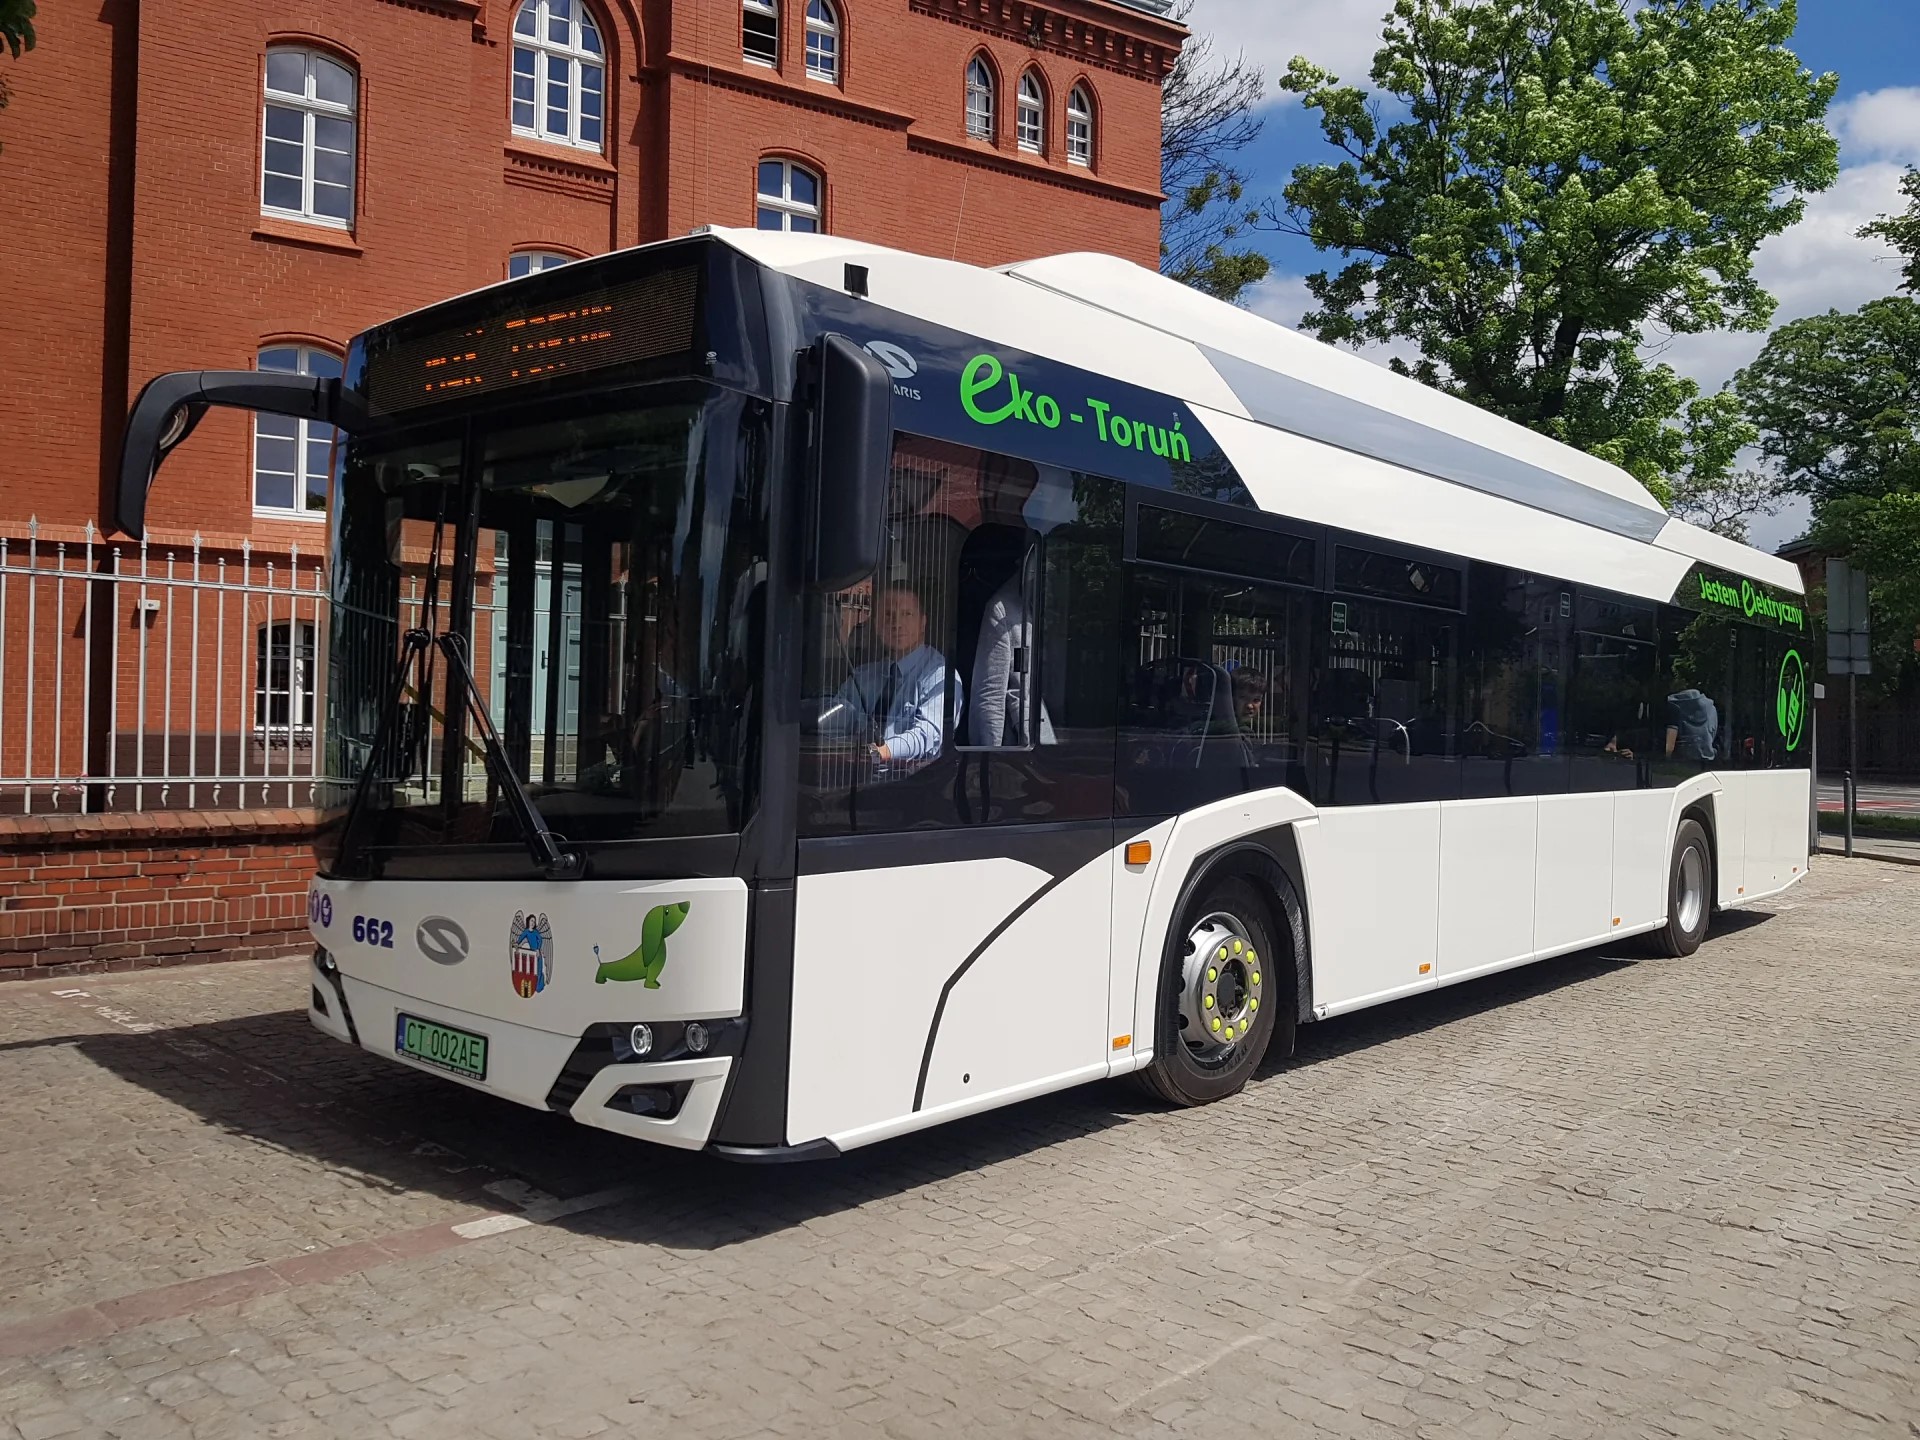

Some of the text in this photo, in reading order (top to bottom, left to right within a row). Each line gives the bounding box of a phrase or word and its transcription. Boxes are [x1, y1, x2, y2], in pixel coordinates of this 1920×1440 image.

[893, 384, 921, 401] ARIS
[959, 353, 1061, 429] eko
[1086, 397, 1191, 463] Toruń
[1698, 572, 1740, 609] Jestem
[353, 915, 393, 949] 662
[407, 1022, 426, 1052] CT
[431, 1029, 480, 1070] 002AE
